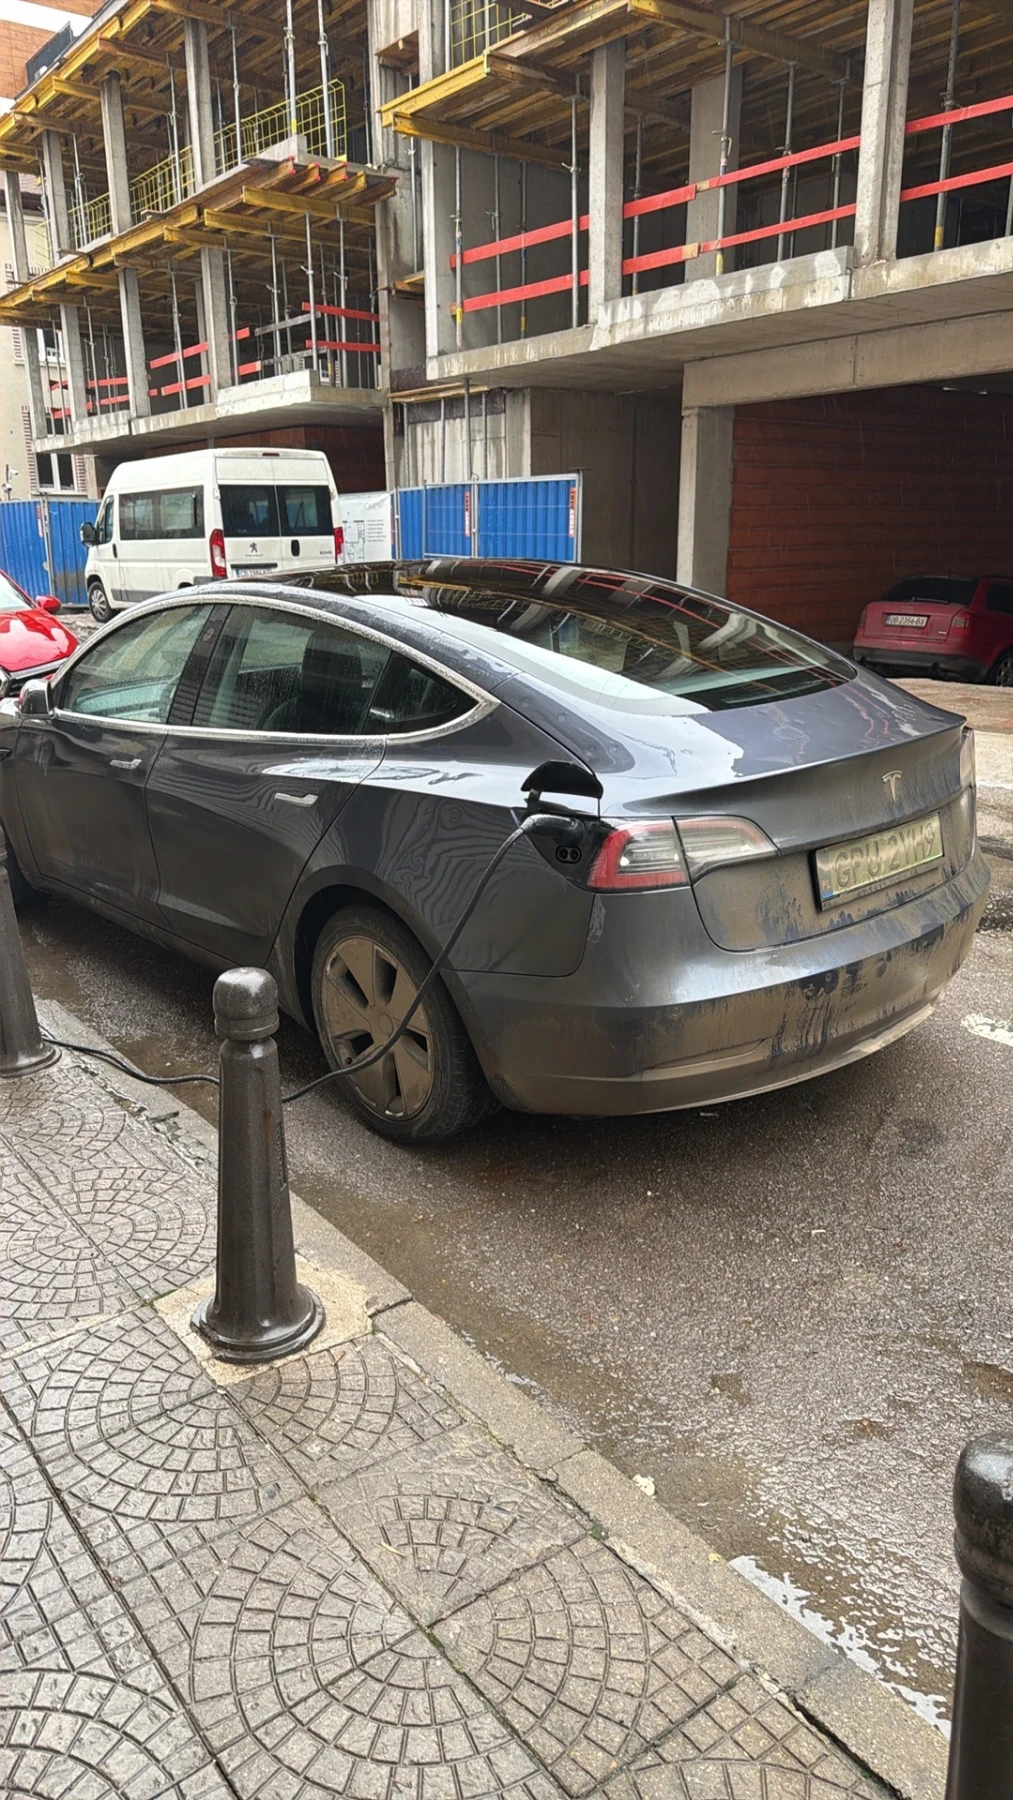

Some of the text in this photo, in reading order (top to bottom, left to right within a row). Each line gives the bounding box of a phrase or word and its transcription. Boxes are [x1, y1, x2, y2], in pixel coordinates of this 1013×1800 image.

[835, 822, 935, 887] GPU 2YH9
[822, 881, 831, 890] PL
